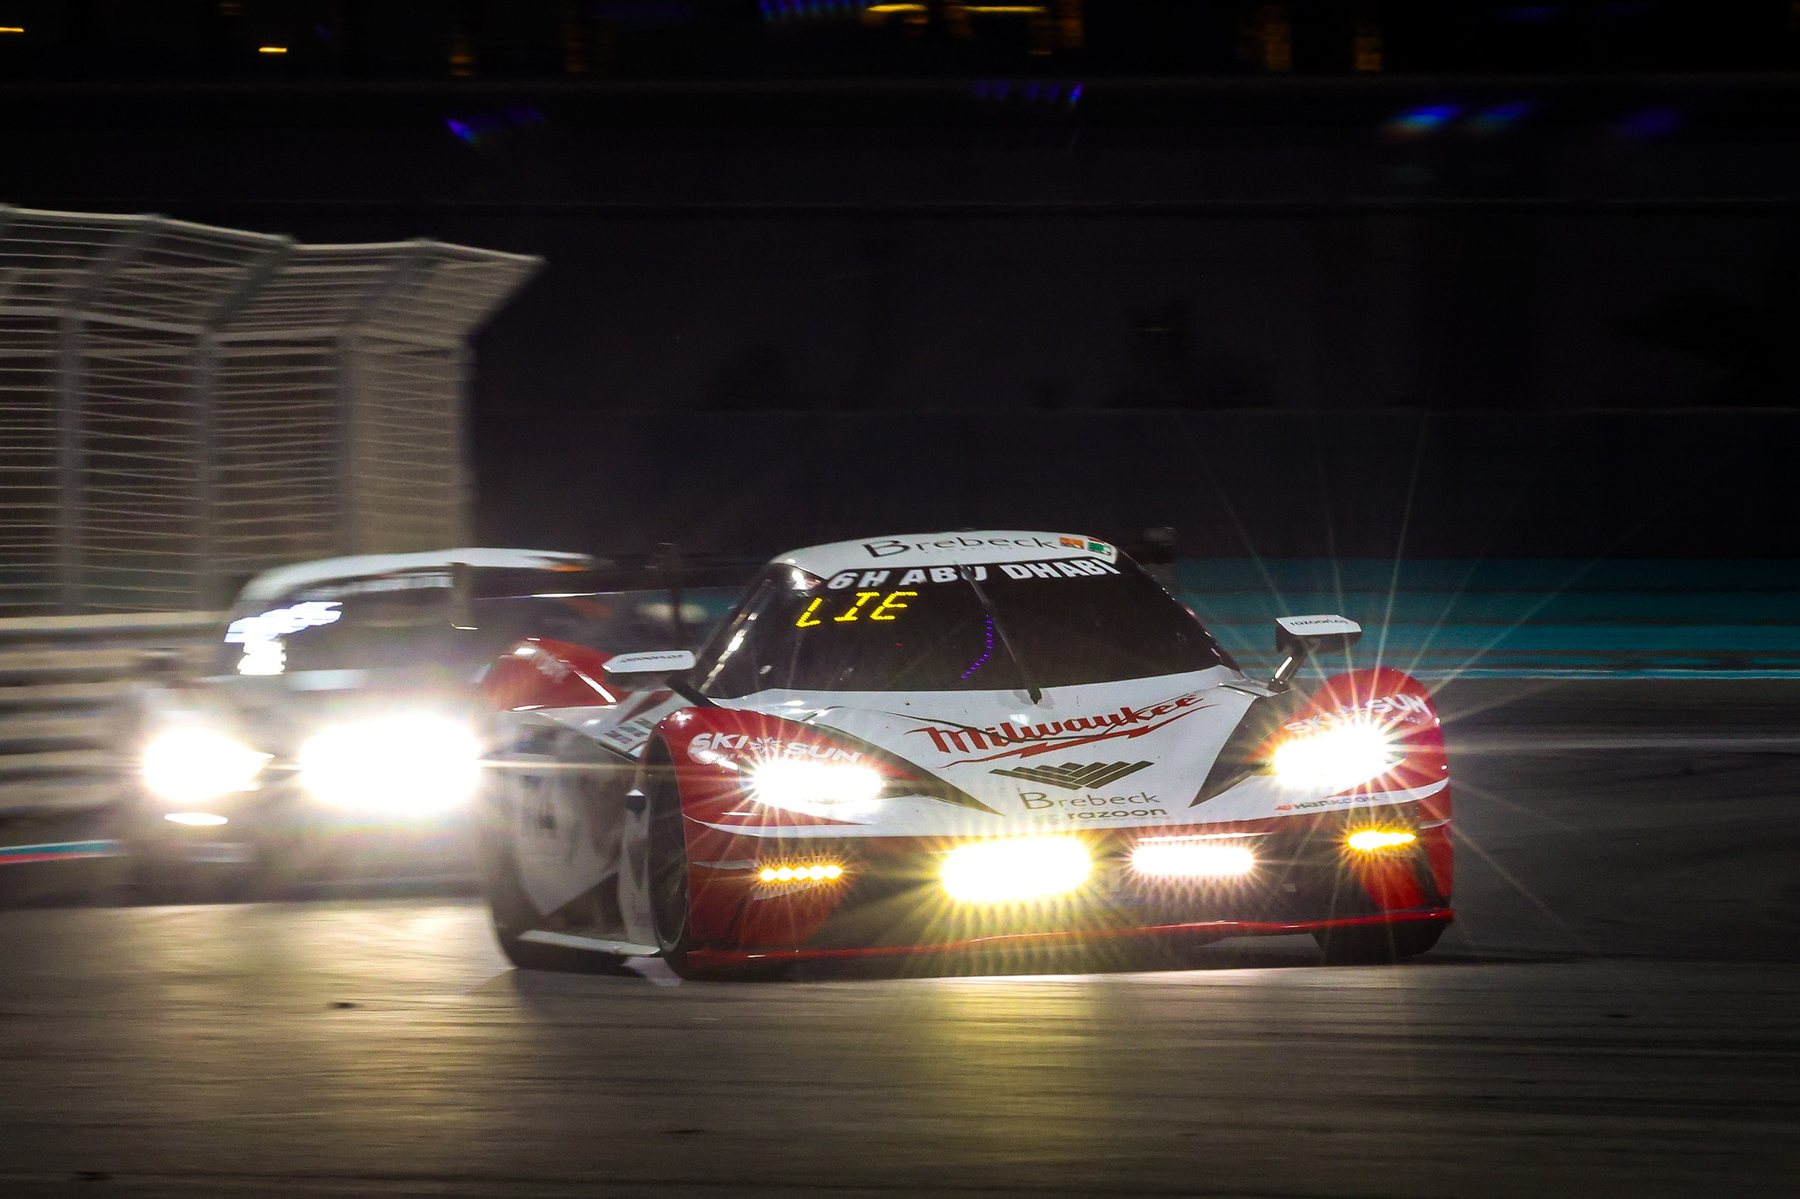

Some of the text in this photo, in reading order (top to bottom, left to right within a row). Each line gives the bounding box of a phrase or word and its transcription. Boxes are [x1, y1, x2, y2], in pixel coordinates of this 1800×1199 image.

[862, 536, 1057, 558] Brebeck
[827, 559, 1121, 590] 6H ABU DHABI
[795, 591, 918, 628] LIE
[1365, 693, 1433, 718] SUN
[904, 694, 1203, 754] Milwaukee
[692, 732, 862, 762] SKI SUN
[1019, 791, 1161, 810] Brebeck
[1068, 808, 1168, 820] razoon
